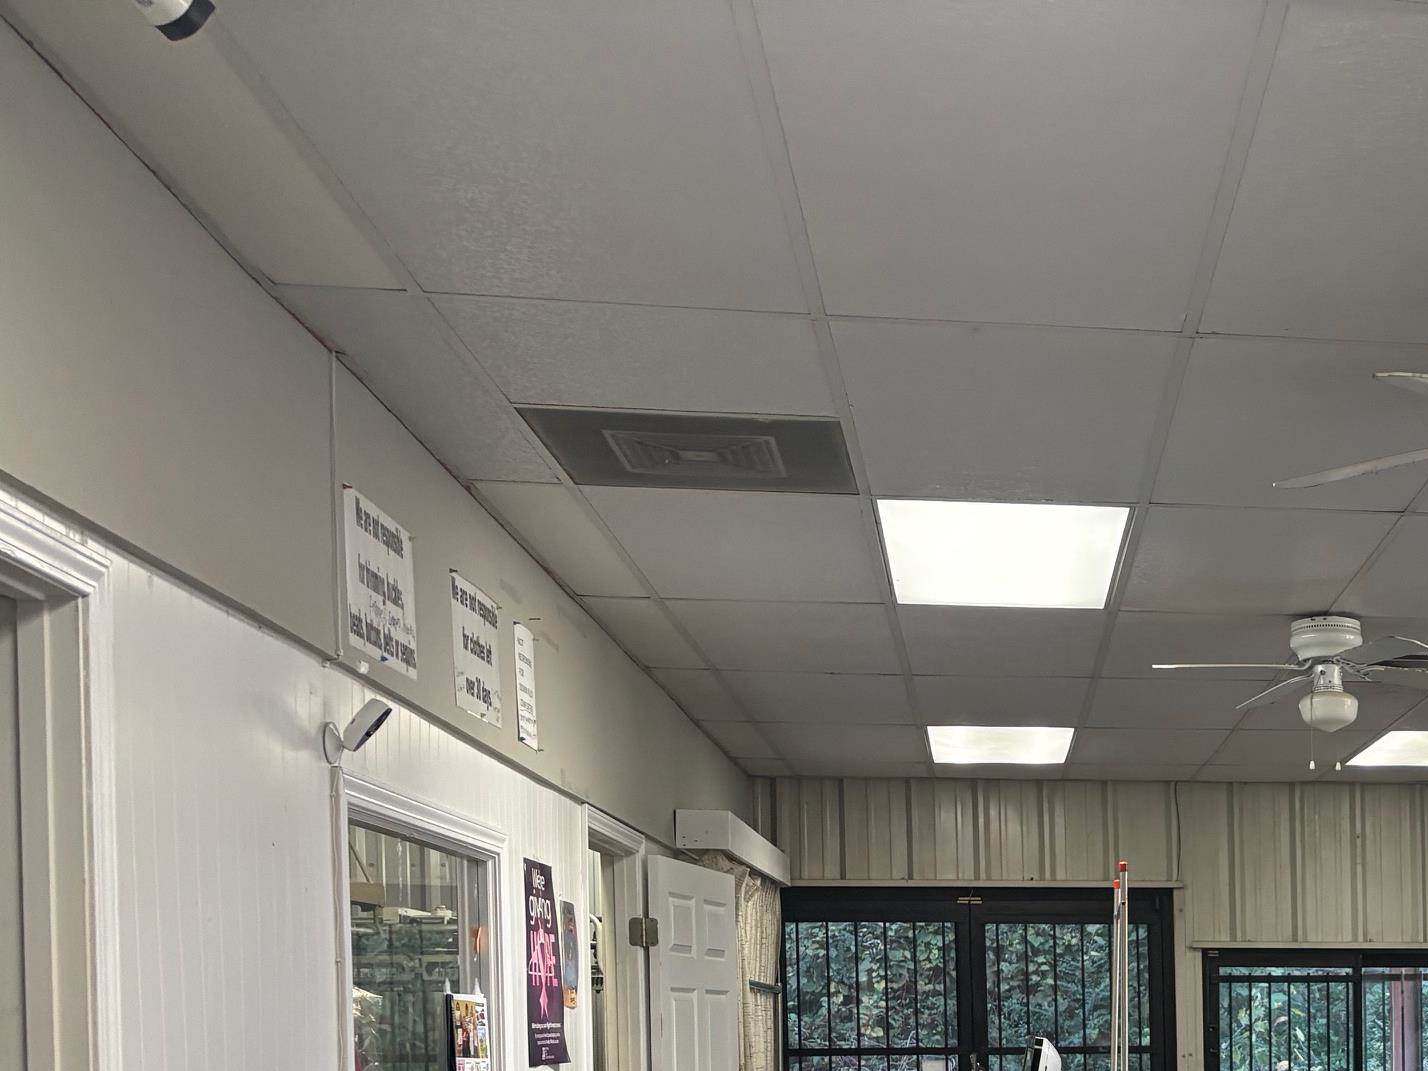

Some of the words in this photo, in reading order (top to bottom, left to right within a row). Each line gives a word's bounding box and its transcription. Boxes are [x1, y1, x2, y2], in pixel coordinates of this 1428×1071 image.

[355, 496, 363, 530] We
[372, 515, 380, 542] not
[380, 522, 403, 559] responsible
[451, 576, 459, 602] We
[460, 587, 468, 608] are
[469, 592, 477, 614] not
[478, 598, 498, 630] responsible
[470, 632, 485, 662] clothes
[466, 677, 475, 697] over
[476, 676, 481, 701] 30
[482, 681, 492, 711] days
[528, 888, 552, 929] giving
